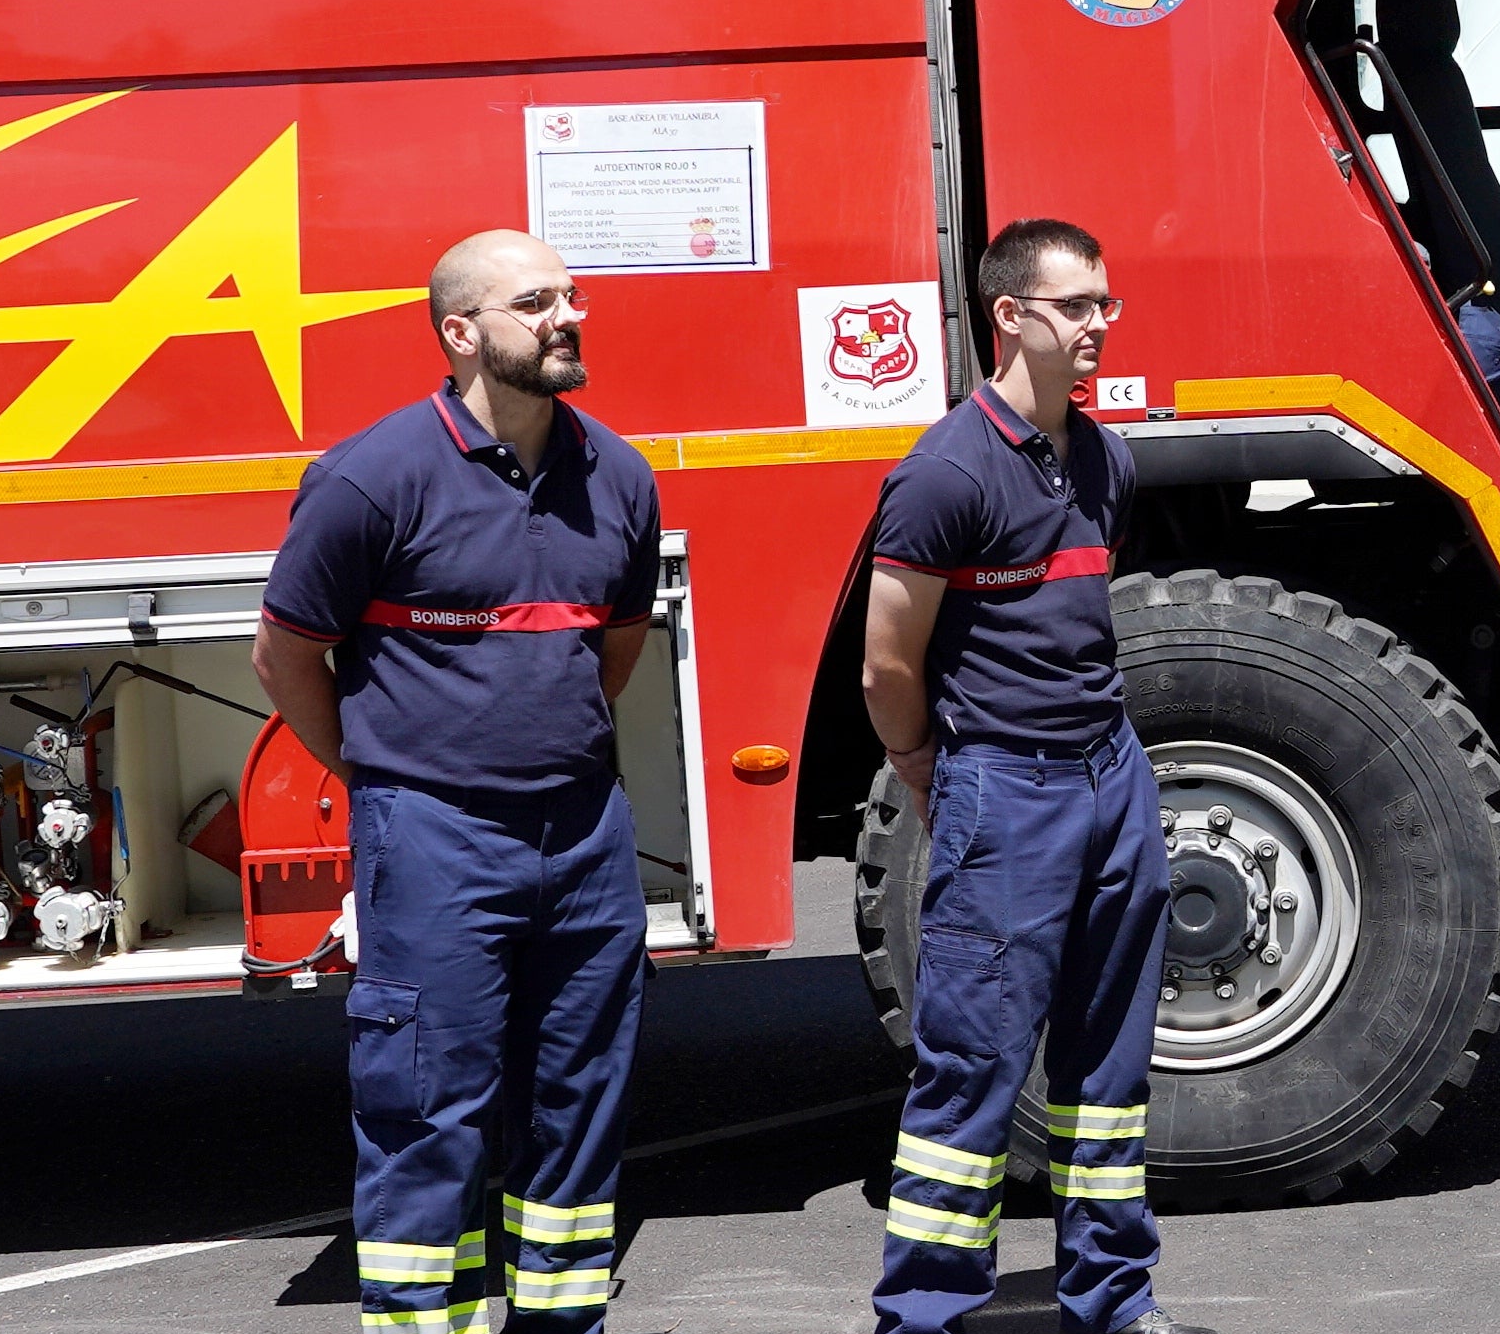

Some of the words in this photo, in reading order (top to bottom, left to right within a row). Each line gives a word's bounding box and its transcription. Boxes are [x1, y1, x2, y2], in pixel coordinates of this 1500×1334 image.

[594, 162, 661, 172] AUTOEXTINTOR
[664, 161, 689, 170] ROJO
[692, 161, 698, 169] 5
[861, 343, 879, 356] 37
[845, 397, 860, 408] DE
[864, 378, 927, 410] VILLANUBLA
[976, 562, 1047, 584] BOMBEROS
[410, 610, 500, 626] BOMBEROS
